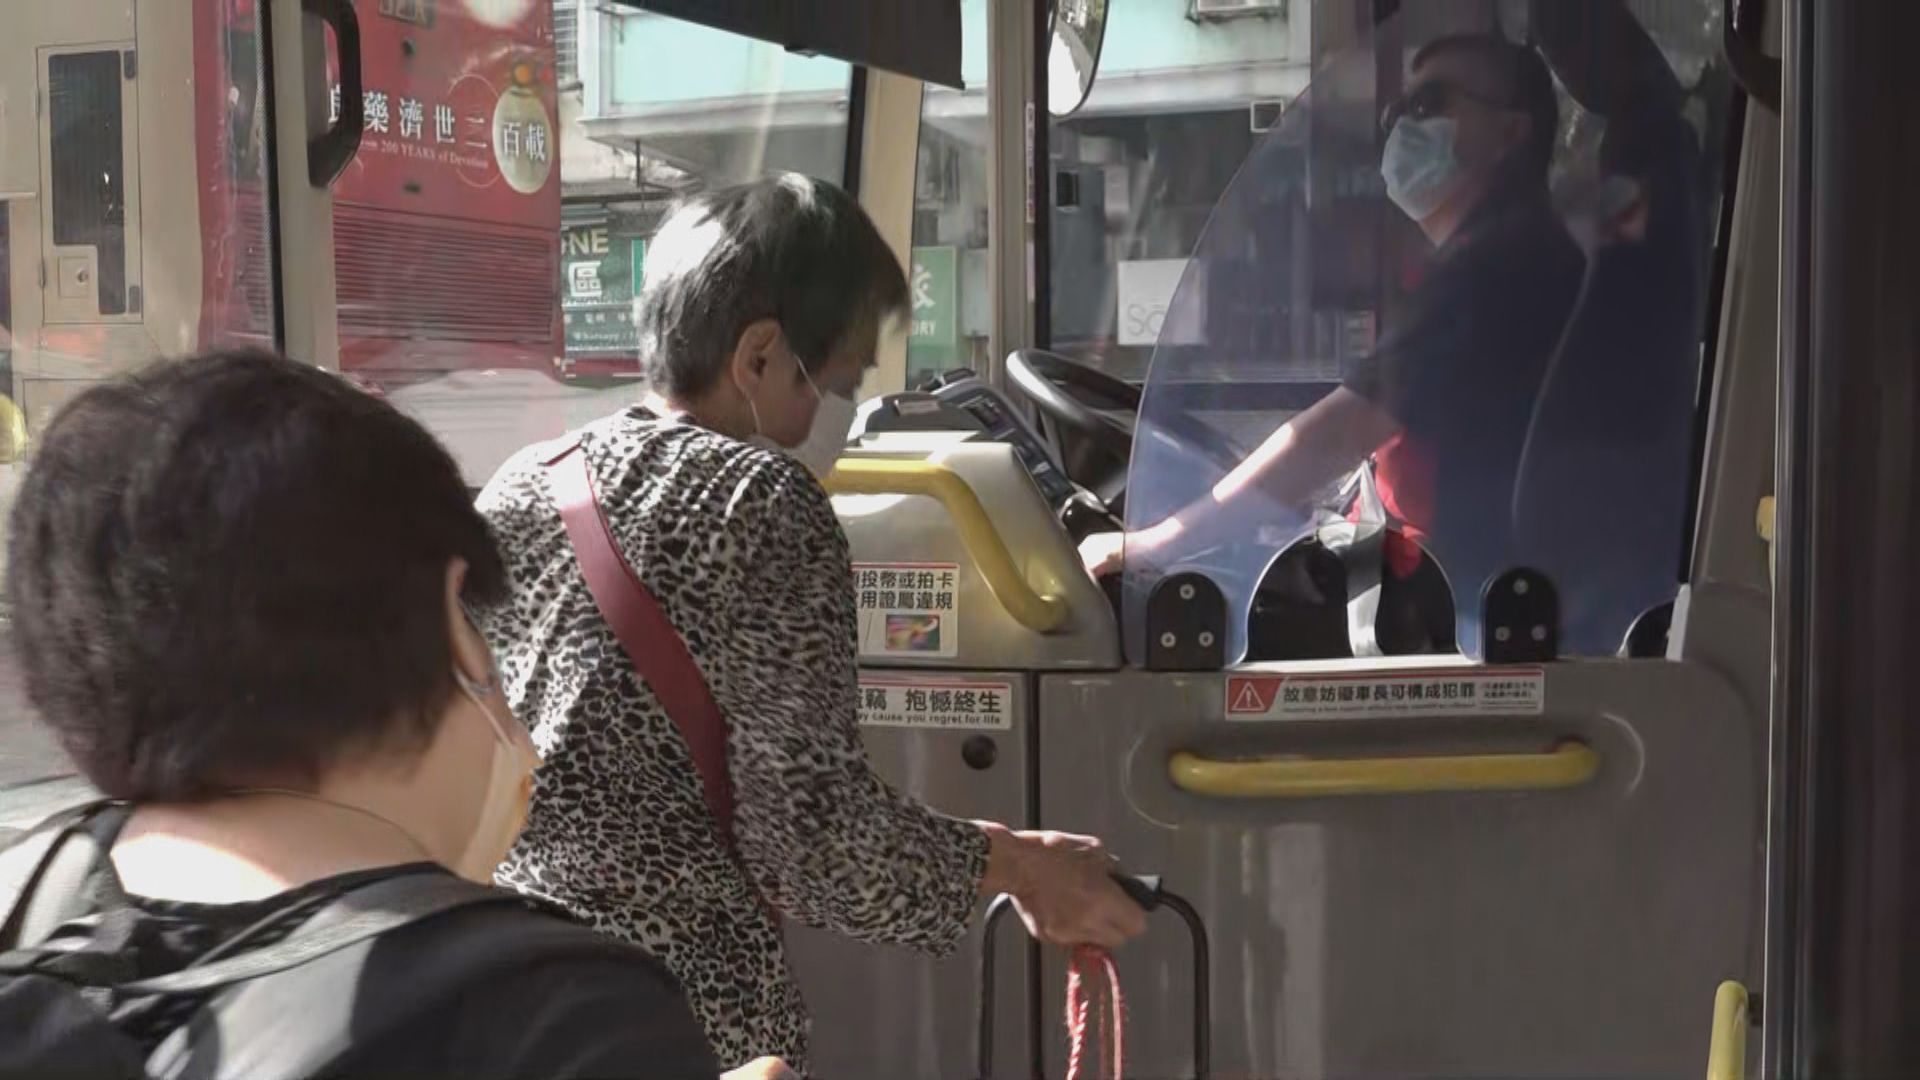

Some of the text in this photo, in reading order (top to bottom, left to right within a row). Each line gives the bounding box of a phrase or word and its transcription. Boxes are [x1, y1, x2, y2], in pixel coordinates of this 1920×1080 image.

[853, 570, 953, 588] 投幣或拍卡
[905, 689, 1001, 713] 抱憾終生
[1284, 682, 1475, 703] 故意妨礙車長可構成犯罪
[906, 714, 926, 724] you
[929, 714, 961, 725] regret
[965, 713, 980, 723] for
[984, 714, 1001, 724] life
